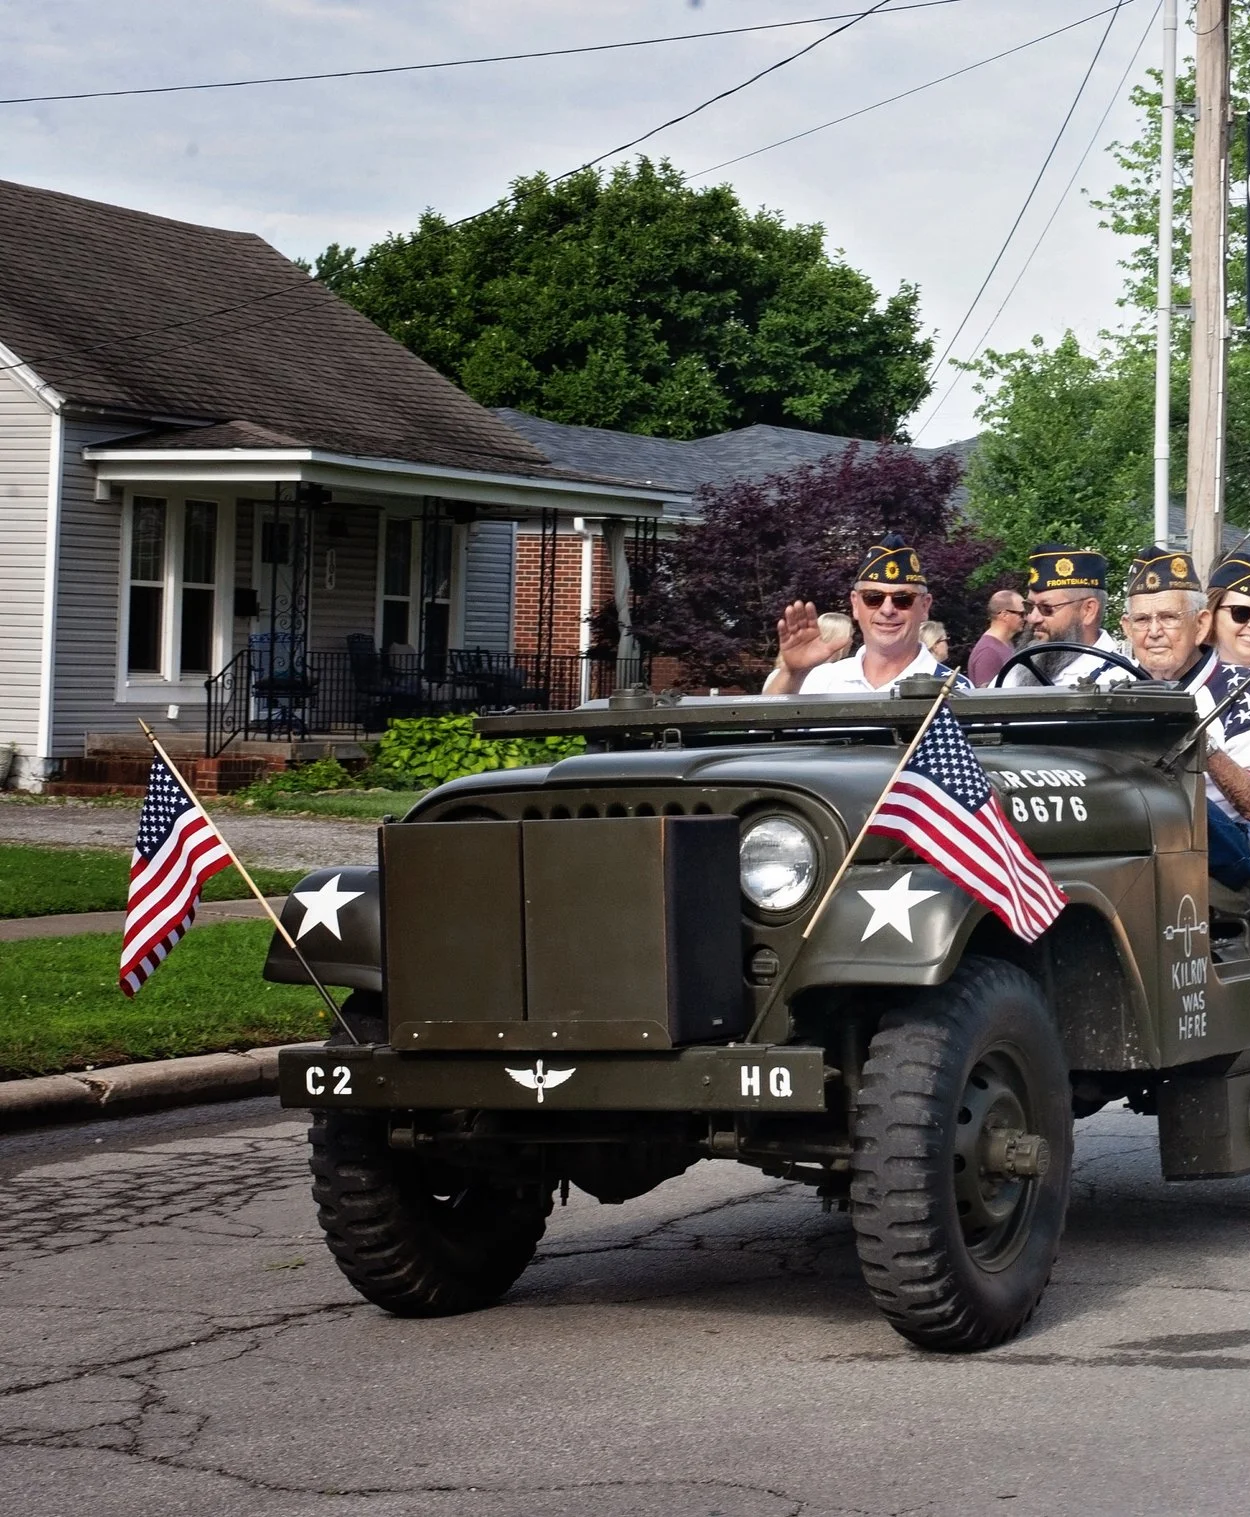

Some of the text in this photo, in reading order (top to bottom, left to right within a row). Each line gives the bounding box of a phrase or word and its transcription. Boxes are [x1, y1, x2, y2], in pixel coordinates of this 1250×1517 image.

[868, 572, 879, 580] 43
[1046, 578, 1090, 587] FRONTENAC,
[1025, 769, 1087, 788] CORP
[1012, 797, 1088, 822] 8676
[1171, 956, 1208, 990] KILROY
[1182, 991, 1205, 1013] WAS
[1178, 1013, 1207, 1040] HERE
